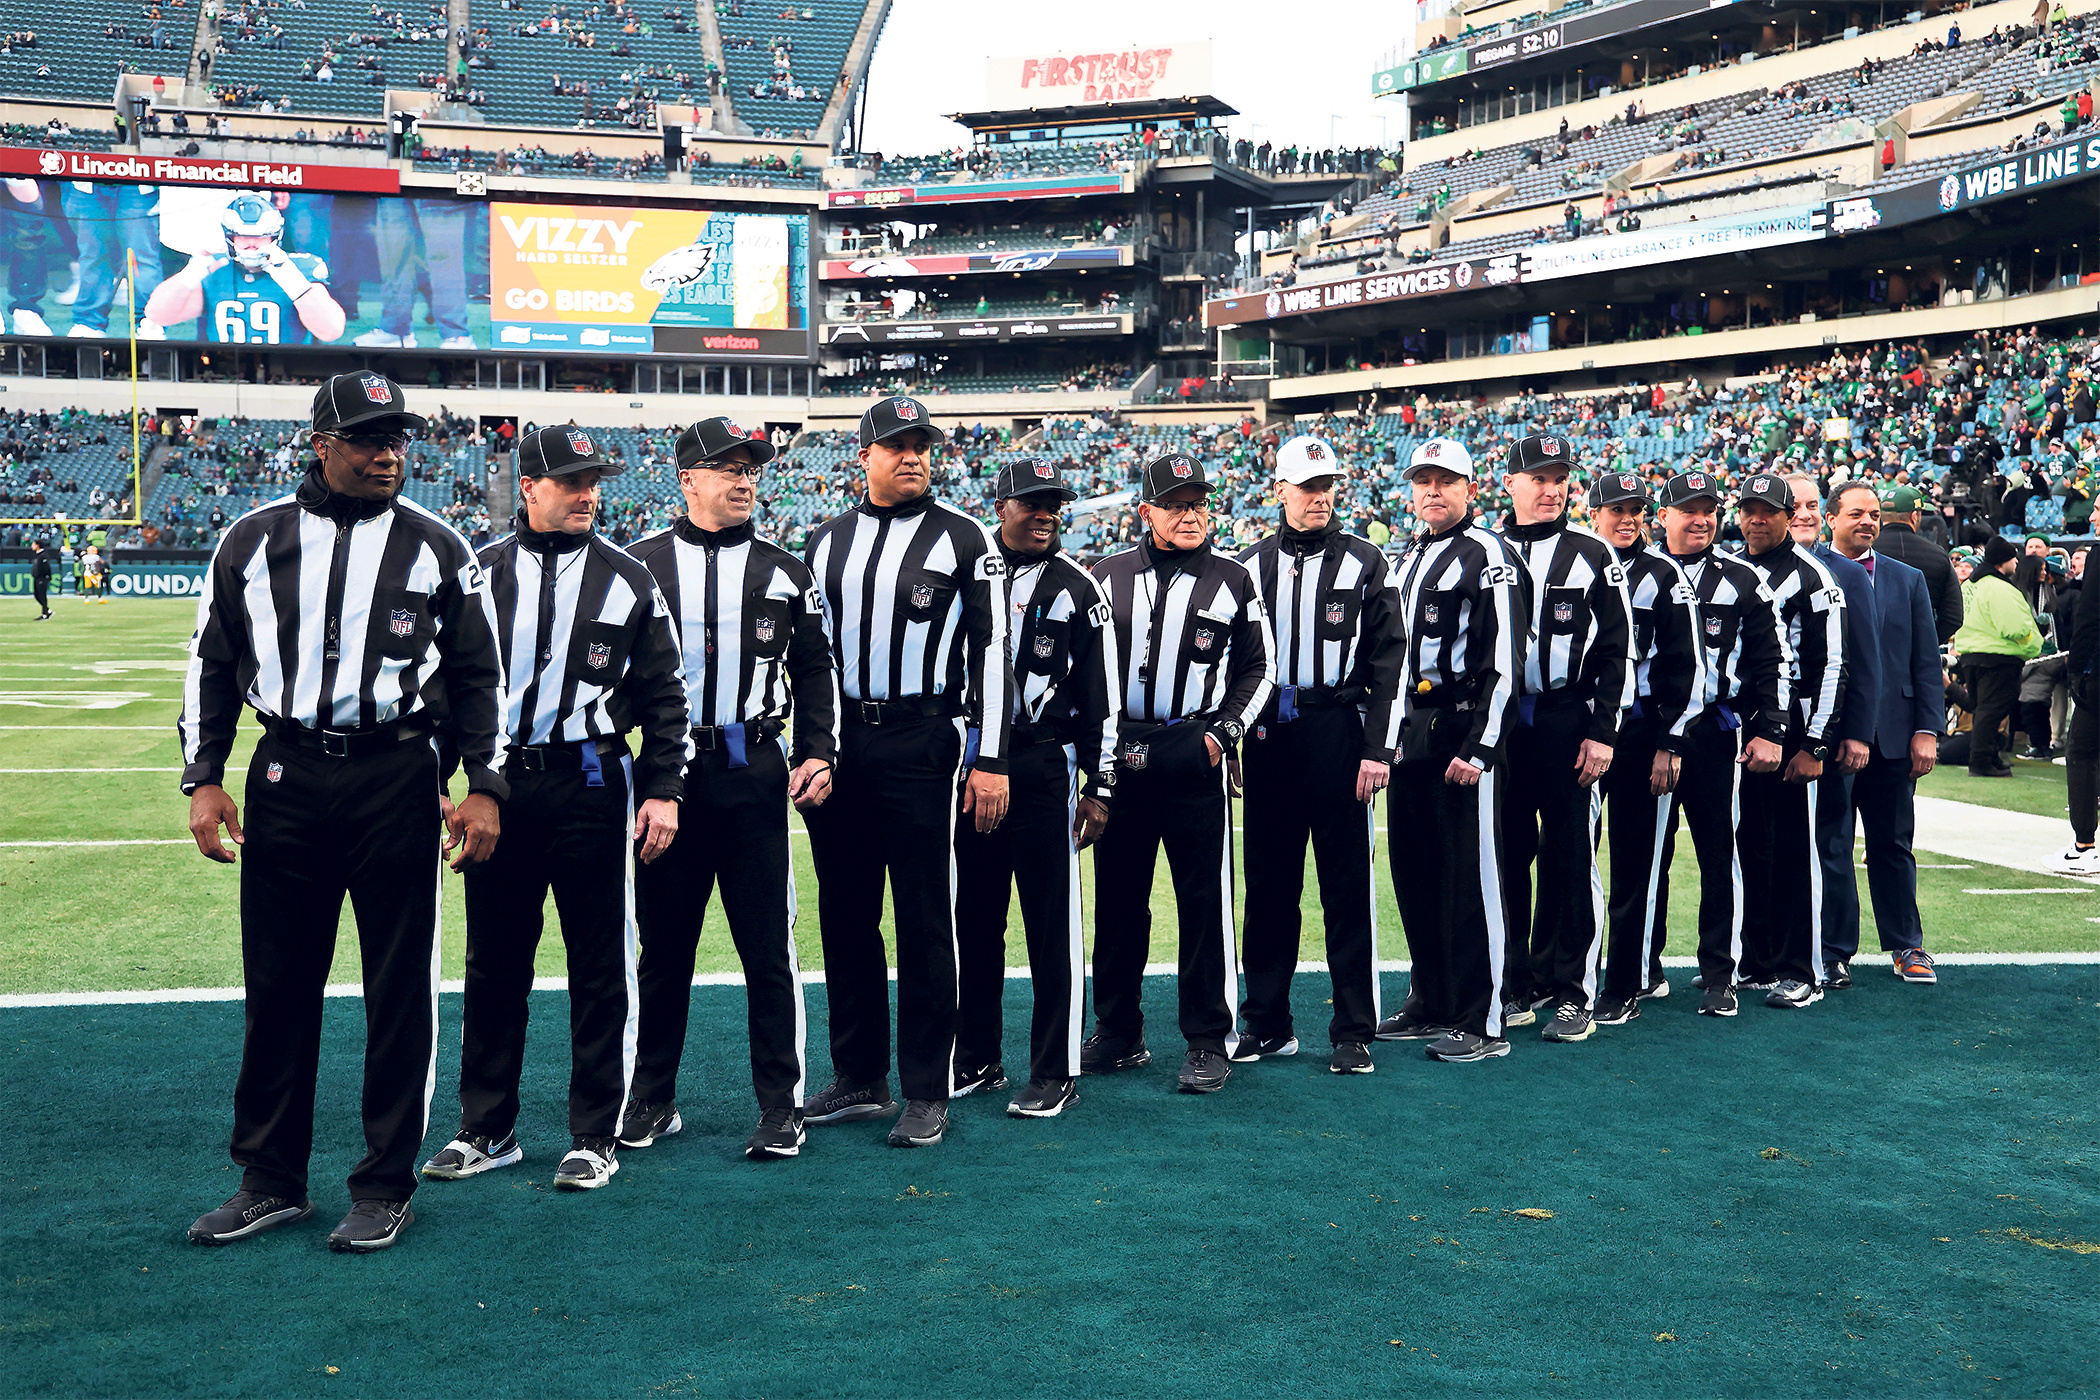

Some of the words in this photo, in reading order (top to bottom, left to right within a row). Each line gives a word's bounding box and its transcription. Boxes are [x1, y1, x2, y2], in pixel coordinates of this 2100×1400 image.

[1522, 29, 1559, 54] 52:10
[1474, 43, 1517, 65] PREGAME
[1404, 68, 1412, 84] 0
[1422, 64, 1431, 79] 0
[1083, 80, 1154, 102] BANK
[71, 155, 150, 178] Lincoln
[154, 159, 249, 183] Financial
[252, 165, 302, 186] Field
[1964, 161, 2018, 201] WBE
[2024, 144, 2080, 187] LINE
[500, 215, 643, 253] VIZZY
[1535, 254, 1576, 270] UTILITY
[1580, 249, 1606, 264] LINE
[1610, 236, 1682, 259] CLEARANCE
[1687, 235, 1695, 246] &
[1701, 230, 1732, 245] TREE
[1738, 217, 1806, 239] TRIMMING
[516, 251, 558, 264] HARD
[563, 253, 628, 266] SELTZER
[505, 288, 549, 310] GO
[555, 289, 635, 313] BIRDS
[1283, 289, 1322, 313] WBE
[1324, 284, 1362, 307] LINE
[1364, 267, 1450, 301] SERVICES
[215, 300, 280, 344] 69
[703, 334, 759, 350] verizon
[983, 555, 1005, 576] 63
[1481, 565, 1515, 585] 122
[1823, 589, 1841, 604] 12
[1089, 605, 1109, 624] 10
[393, 621, 412, 633] NFL
